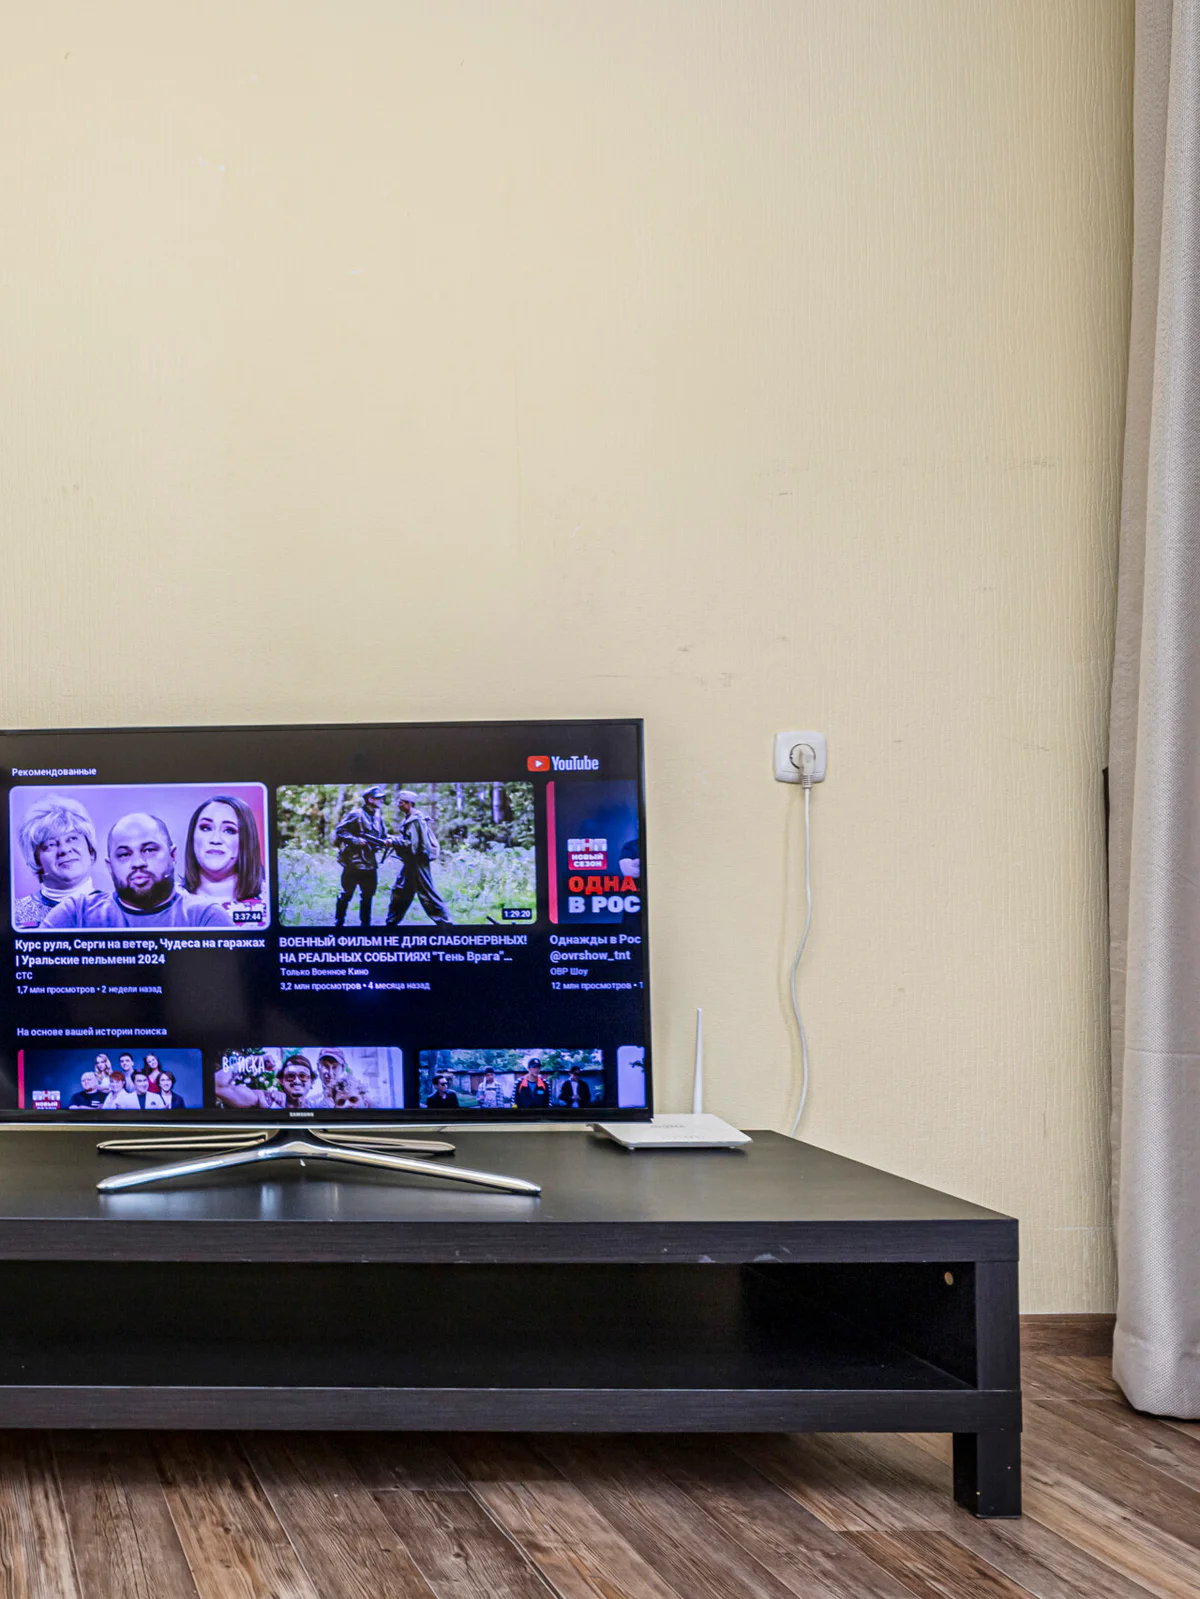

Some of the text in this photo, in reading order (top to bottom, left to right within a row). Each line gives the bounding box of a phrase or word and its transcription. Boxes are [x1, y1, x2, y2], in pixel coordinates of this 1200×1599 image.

[551, 755, 599, 771] YouTube
[11, 768, 97, 777] Рекомендованные
[568, 875, 637, 895] ОДНА
[568, 895, 641, 914] В РОС
[235, 912, 261, 921] 3:37:44
[504, 910, 531, 918] 1:29:20
[15, 938, 266, 952] Курс руля, Серги на ветер, Чудеса на гаражах
[279, 935, 528, 948] ВОЕННЫЙ ФИЛЬМ НЕ ДЛЯ СЛАБОНЕРВНЫХ!
[549, 934, 642, 946] Однажды в Рос
[21, 954, 80, 968] Уральские
[81, 955, 136, 965] пельмени
[138, 954, 166, 964] 2024
[280, 953, 297, 963] НА
[299, 953, 362, 963] РЕАЛЬНЫХ
[364, 951, 431, 962] СОБЫТИЯХ!
[432, 951, 465, 961] "Тень
[549, 949, 631, 963] @ovrshow_tnt
[15, 971, 33, 980] СТС
[280, 967, 369, 976] Только Военное Кино
[550, 967, 589, 977] ОВР Шоу
[16, 985, 162, 995] 1,7 млн просмотров 2 недели назад
[280, 982, 292, 991] 3,2
[311, 982, 362, 992] просмотров
[368, 981, 374, 990] 4
[374, 982, 406, 991] месяца
[406, 982, 431, 991] назад
[551, 982, 562, 990] 12
[580, 983, 633, 992] просмотров
[16, 1028, 30, 1036] На
[65, 1027, 94, 1036] вашей
[95, 1029, 133, 1038] истории
[134, 1028, 168, 1036] поиска
